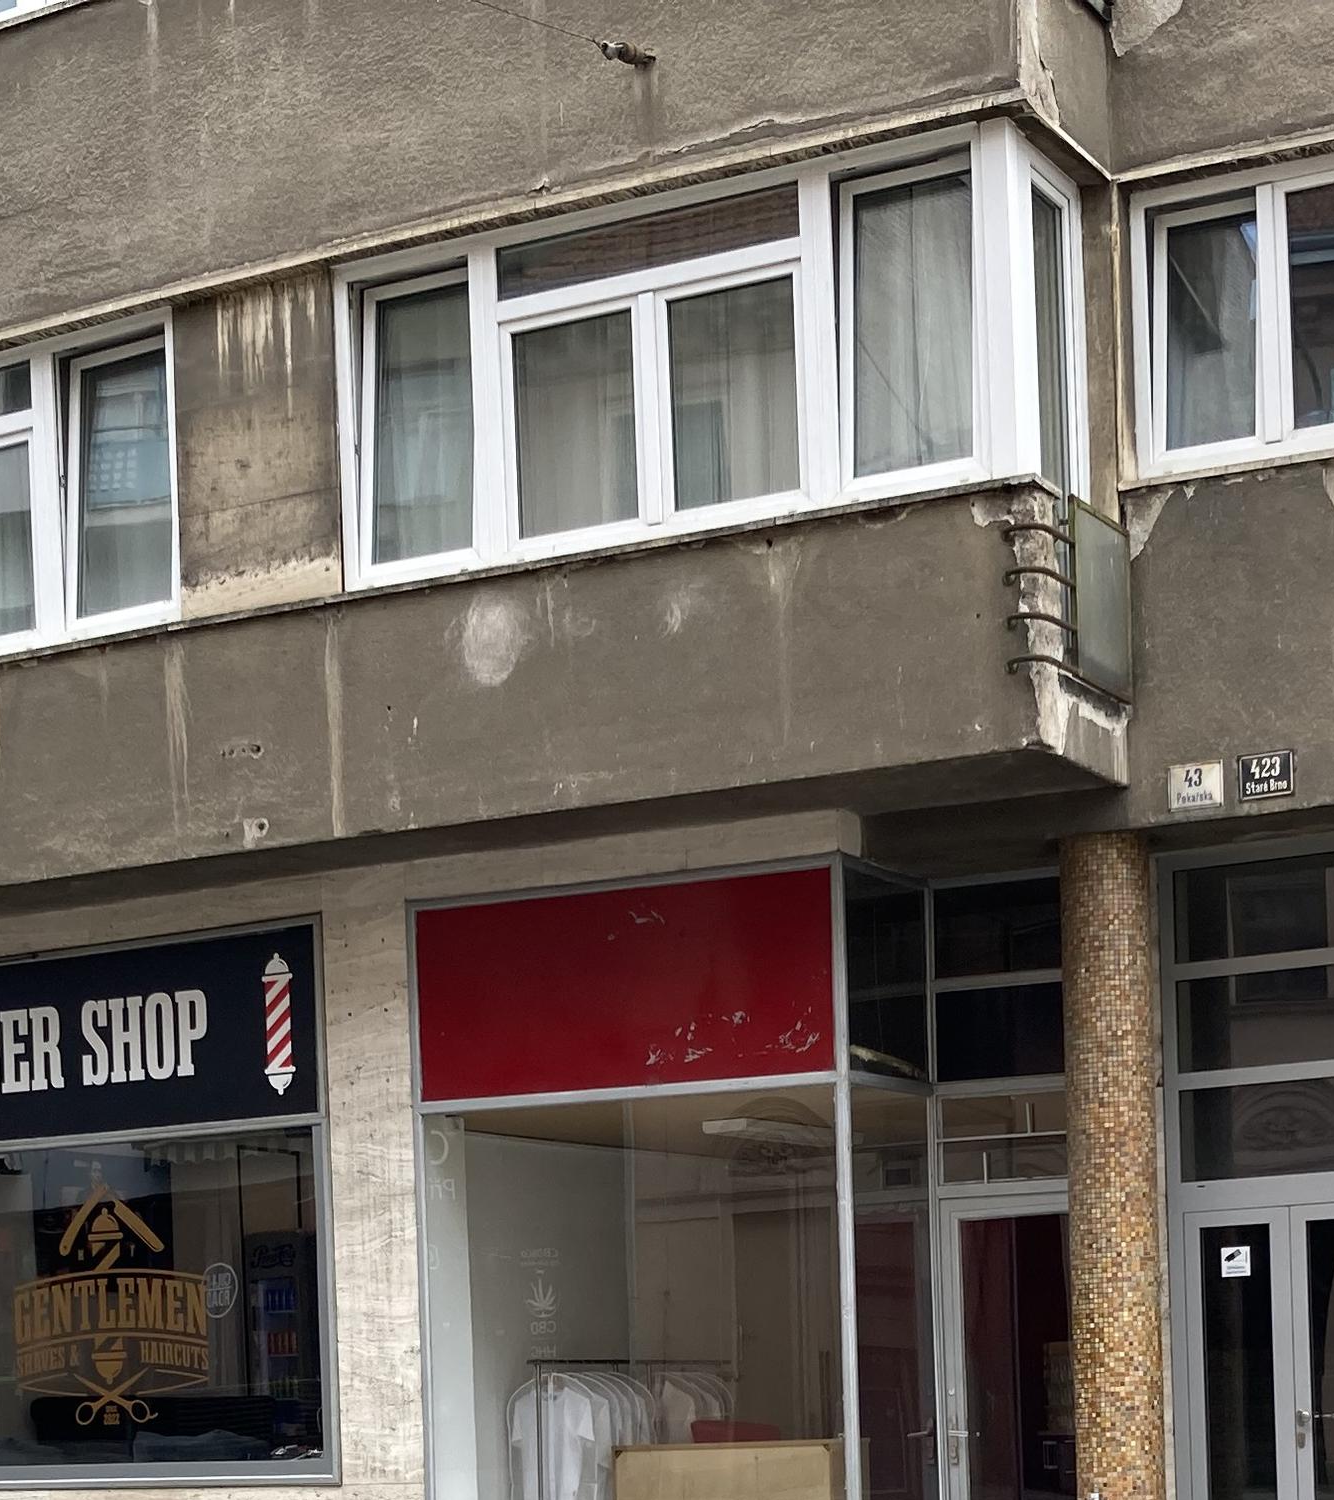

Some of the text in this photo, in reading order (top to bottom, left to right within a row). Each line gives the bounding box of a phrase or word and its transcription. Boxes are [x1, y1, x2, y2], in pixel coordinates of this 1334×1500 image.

[1184, 768, 1203, 788] 43
[1250, 756, 1280, 779] 423
[1245, 778, 1287, 795] Staré Brno
[81, 989, 208, 1086] SHOP
[14, 1277, 208, 1345] GENTLEMEN
[140, 1340, 209, 1370] HAIRCUTS
